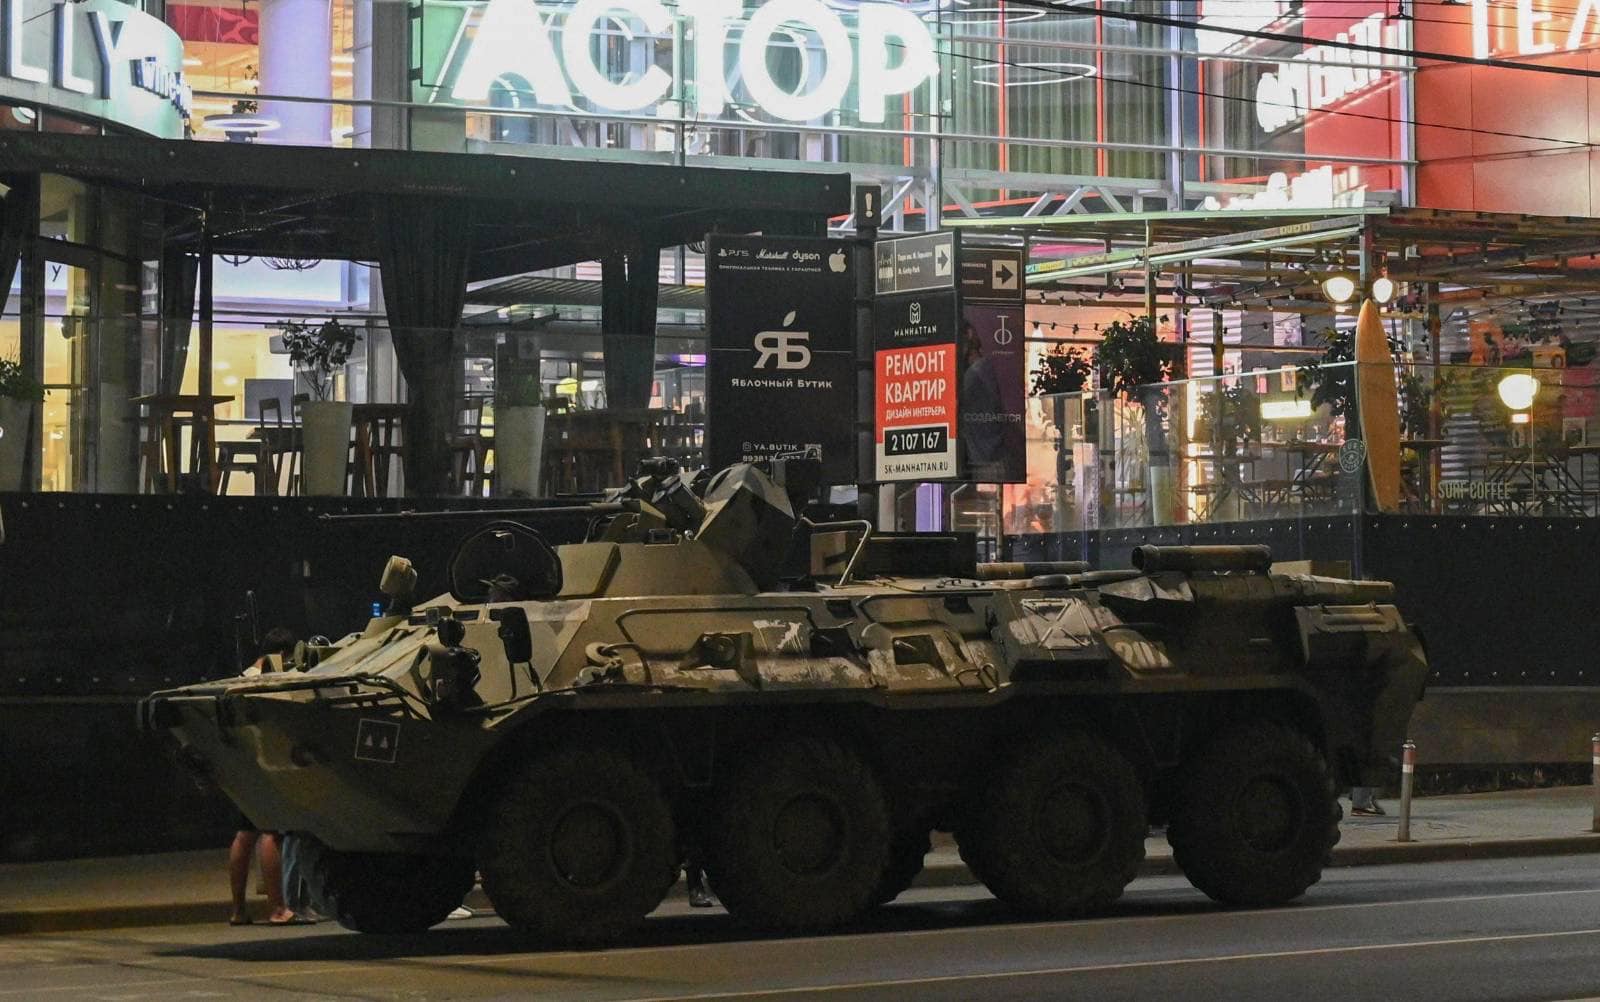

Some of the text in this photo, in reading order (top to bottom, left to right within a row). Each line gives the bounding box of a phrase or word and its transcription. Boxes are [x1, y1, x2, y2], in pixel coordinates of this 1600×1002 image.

[728, 249, 749, 257] PS5
[792, 250, 820, 262] dyson
[894, 325, 937, 337] MANHATTAN
[885, 350, 946, 377] РЕМОНТ
[885, 378, 946, 404] КВАРТИР
[885, 405, 946, 422] ДИЗАЙН ИНТЕРЬЕРА
[753, 443, 798, 451] YA.BUTIK
[891, 431, 940, 451] 2 107 167
[884, 461, 949, 474] SK-MANHATTAN.RU
[1438, 480, 1511, 499] SURF COFFEE
